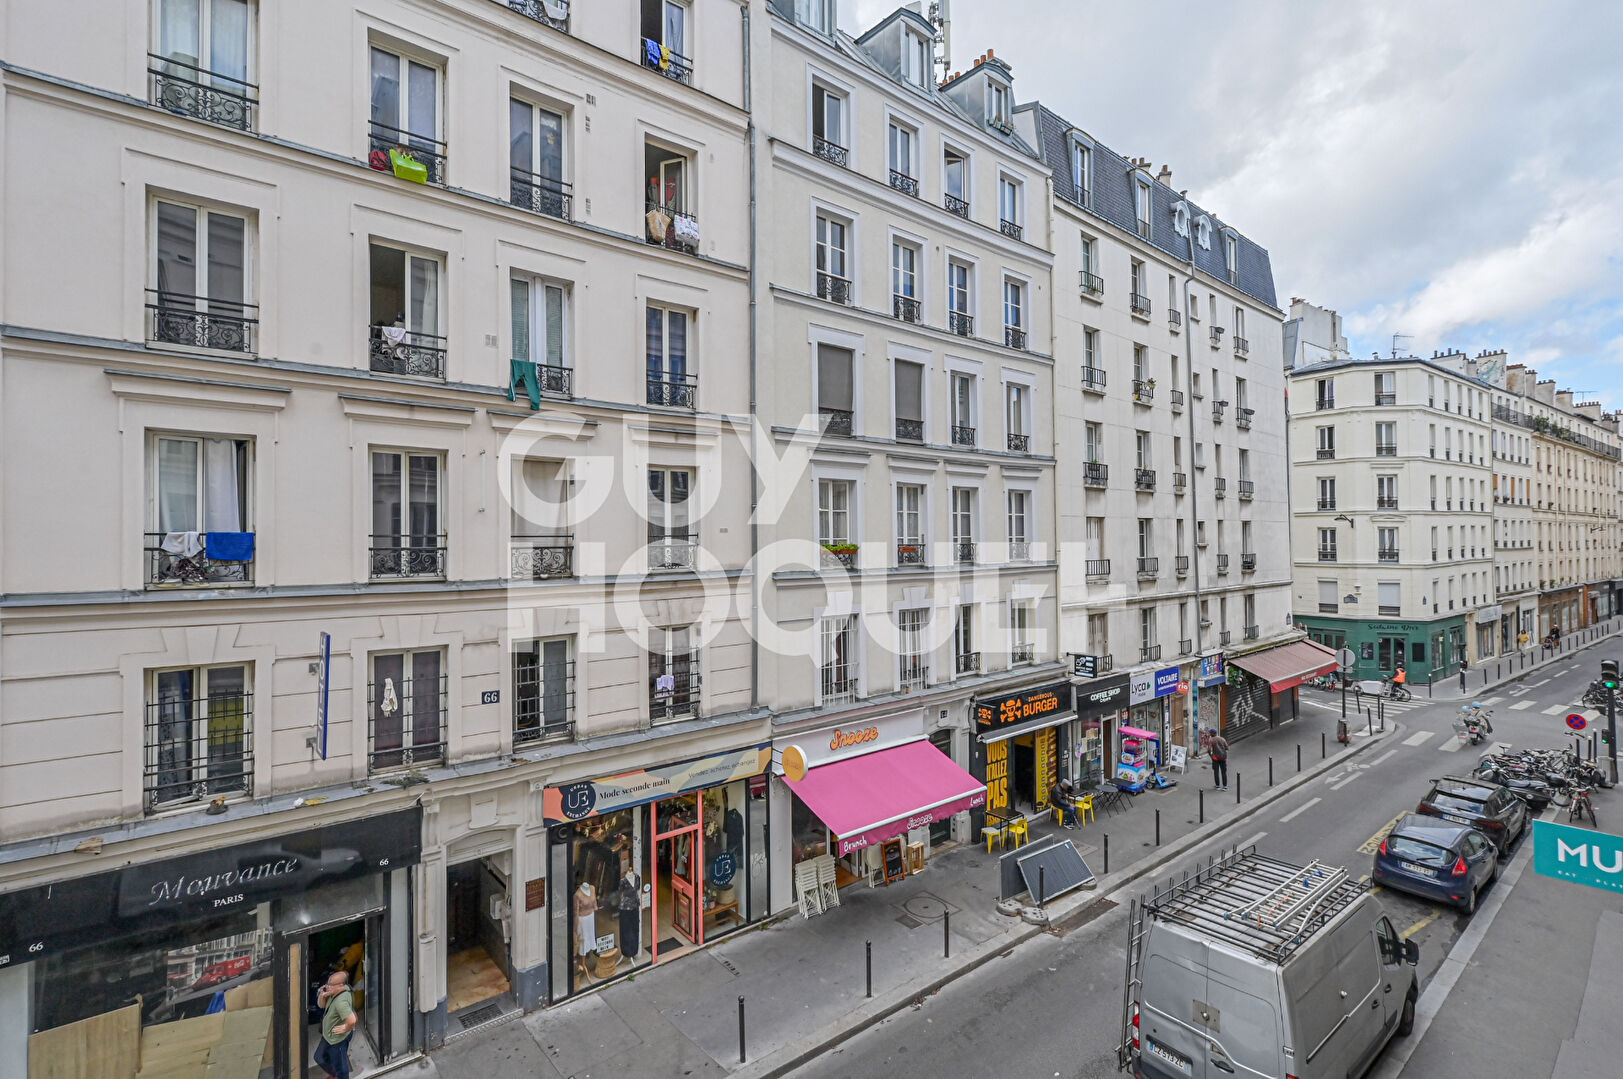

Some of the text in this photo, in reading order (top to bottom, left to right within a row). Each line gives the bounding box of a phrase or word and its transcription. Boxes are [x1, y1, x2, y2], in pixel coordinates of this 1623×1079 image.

[1158, 673, 1178, 685] VOLTAIRE
[318, 634, 326, 754] HOTEL
[1090, 687, 1121, 701] COFFEE SHOP
[1131, 682, 1147, 695] Lyca
[484, 692, 498, 703] 66
[1023, 697, 1058, 717] BURGER
[830, 727, 879, 751] Snooze
[599, 777, 671, 800] Mode seconde main
[969, 795, 985, 807] Lunch
[843, 836, 868, 852] Brunch
[380, 858, 390, 866] 66
[1557, 837, 1623, 874] MU
[213, 894, 244, 908] PARIS
[29, 942, 44, 953] 66
